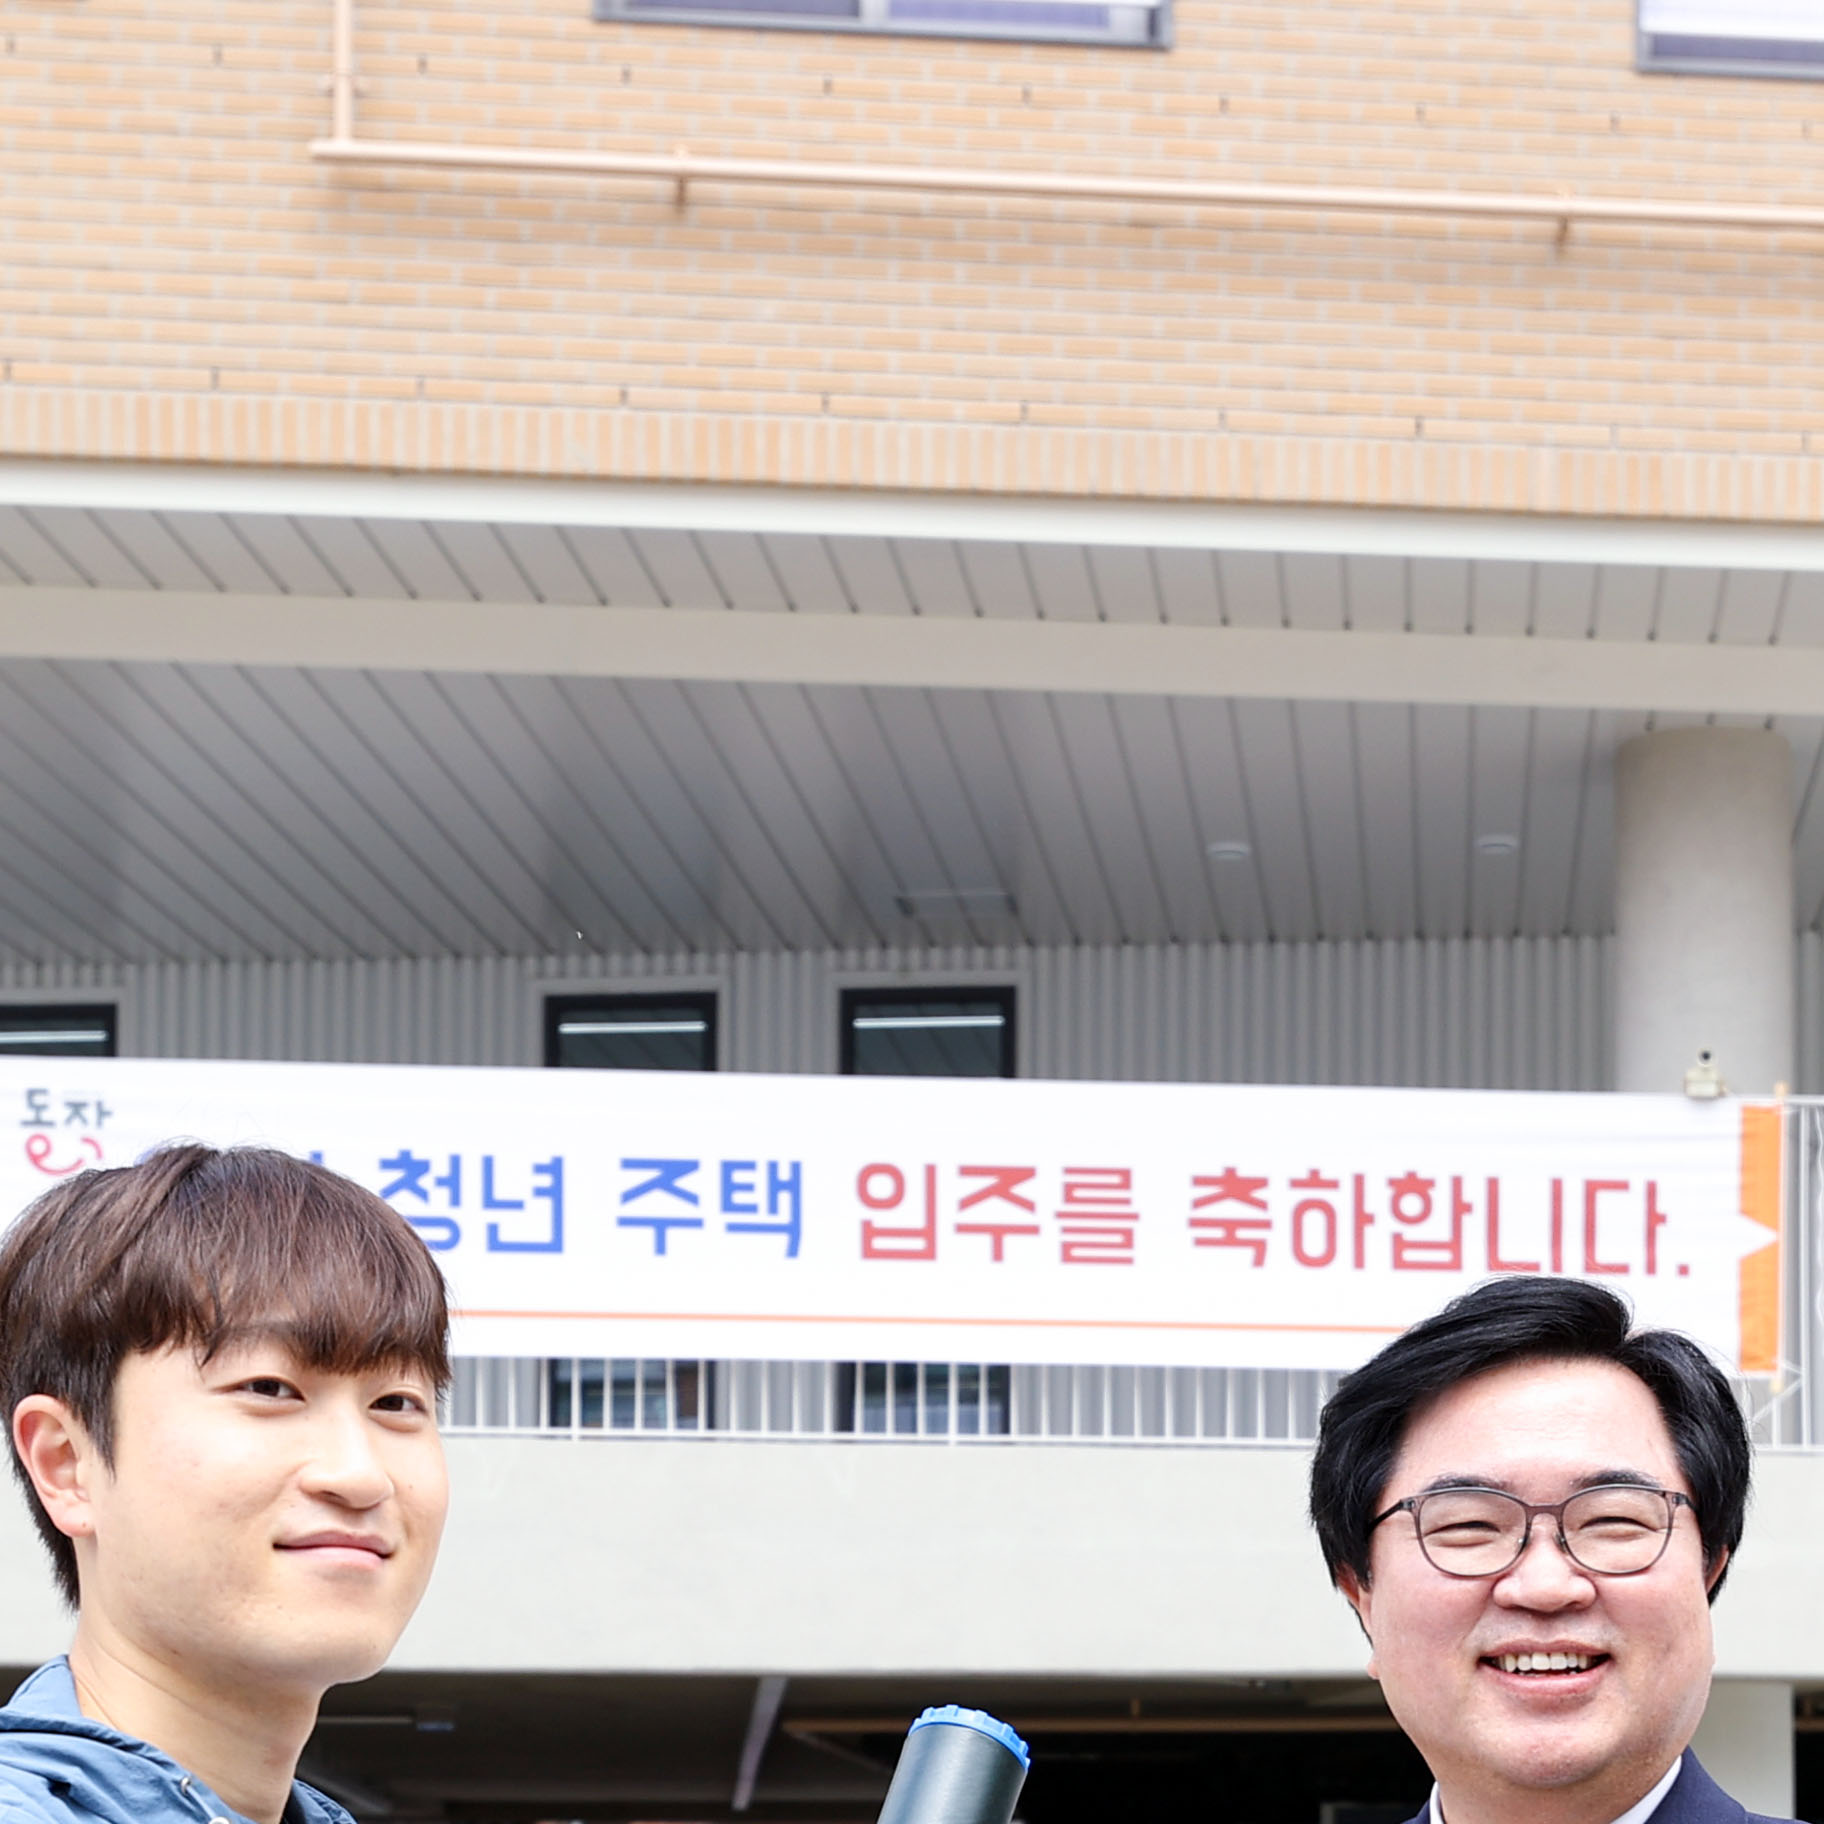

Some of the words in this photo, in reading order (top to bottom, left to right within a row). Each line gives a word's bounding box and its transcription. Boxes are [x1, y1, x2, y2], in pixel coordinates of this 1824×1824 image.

[379, 1149, 565, 1254] 청년
[616, 1156, 805, 1262] 주택
[857, 1163, 1139, 1267] 입주를
[1188, 1168, 1692, 1279] 축하합니다.
